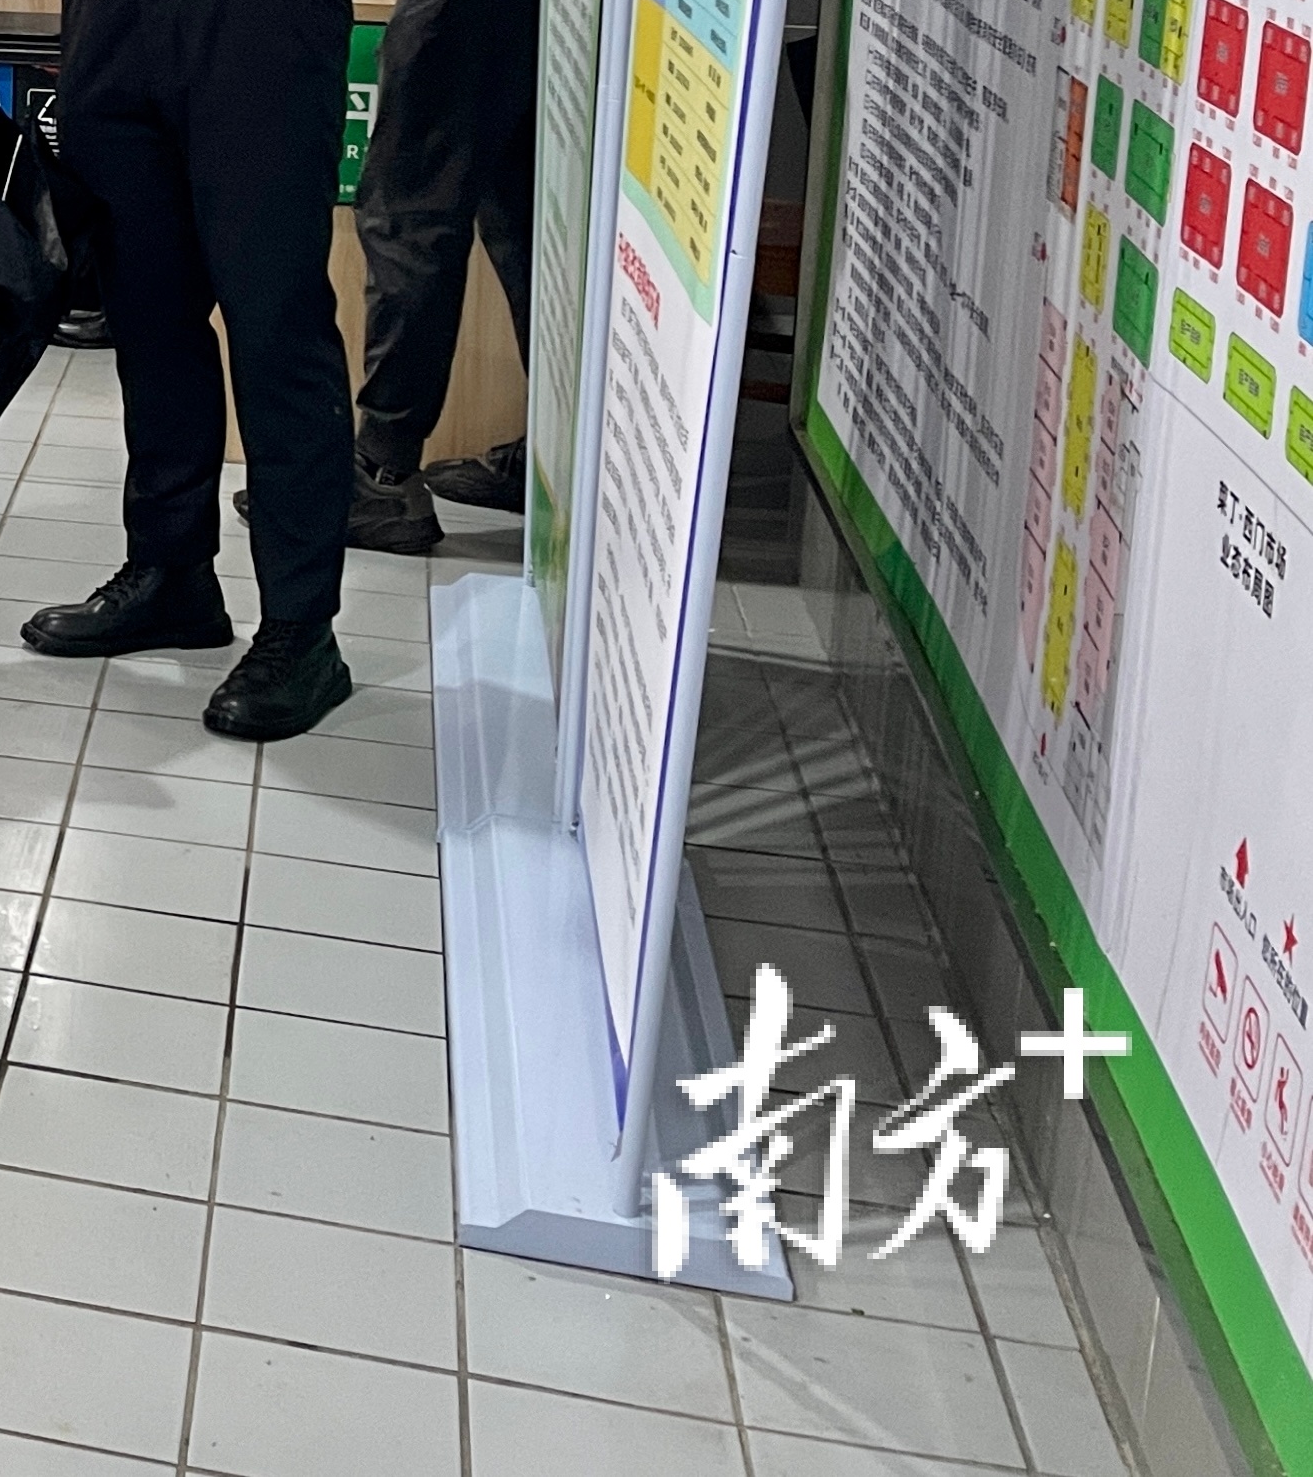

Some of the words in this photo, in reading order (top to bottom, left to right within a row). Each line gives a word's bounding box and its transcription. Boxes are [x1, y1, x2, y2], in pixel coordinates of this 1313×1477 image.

[1219, 533, 1274, 619] 业态布局图
